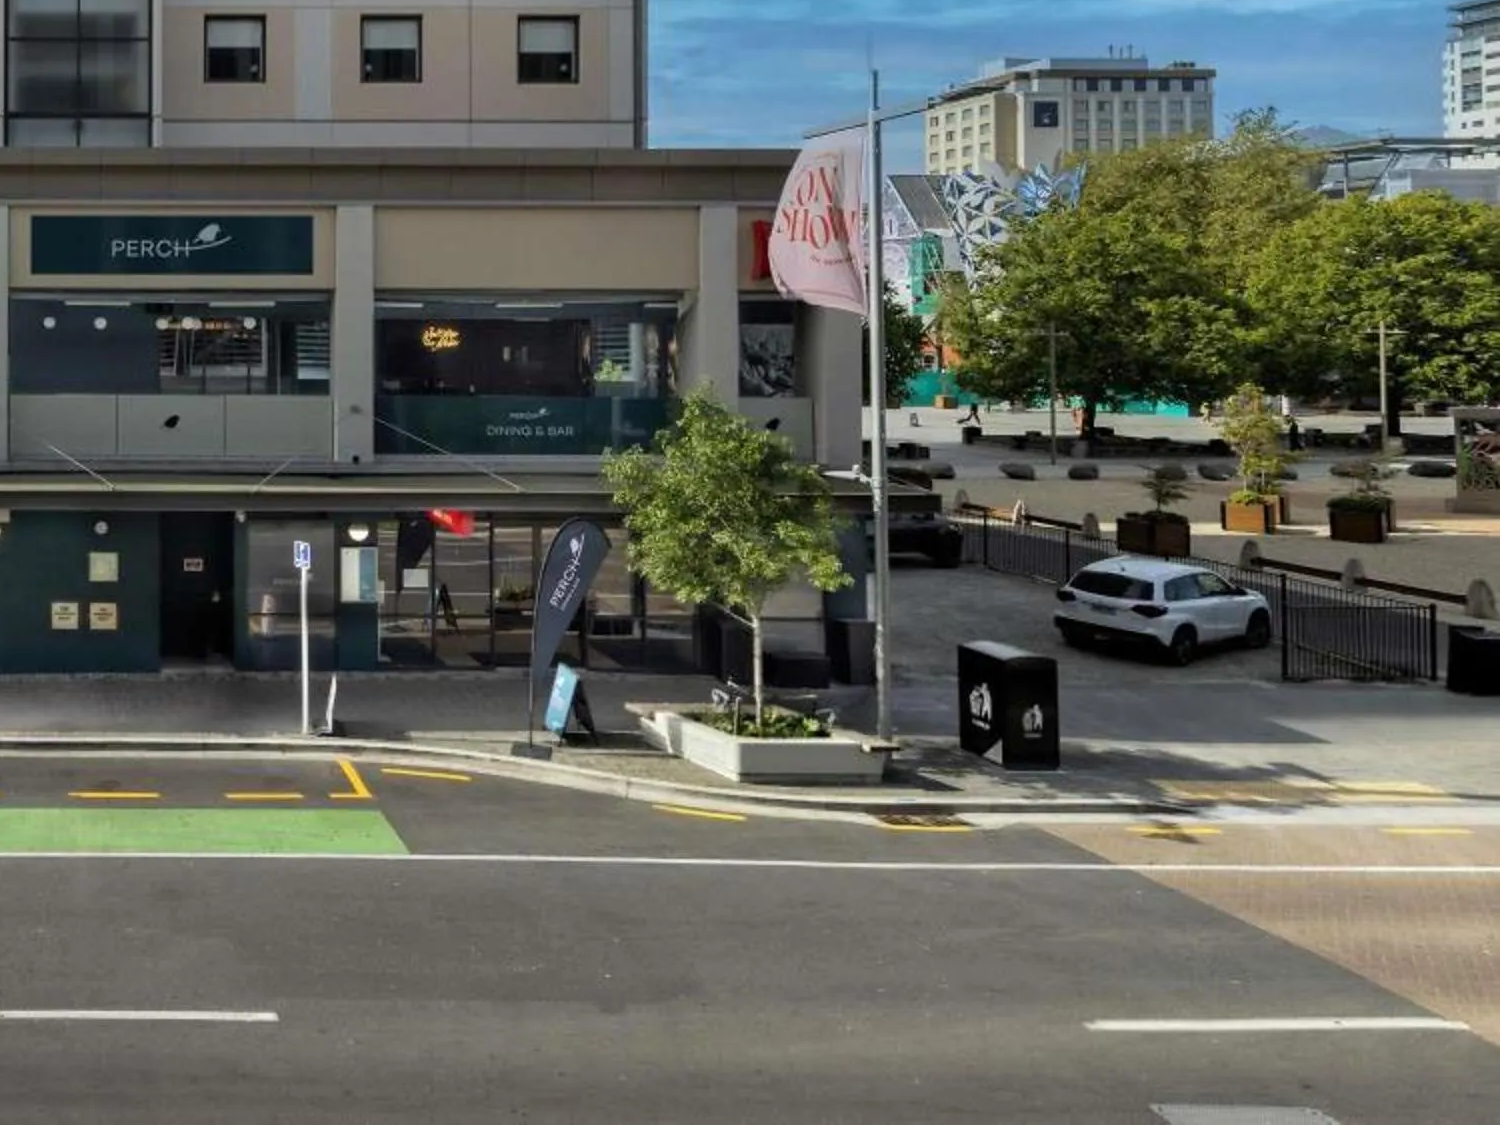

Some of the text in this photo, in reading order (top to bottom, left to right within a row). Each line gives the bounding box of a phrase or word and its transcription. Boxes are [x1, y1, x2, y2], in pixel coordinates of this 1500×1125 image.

[794, 166, 840, 206] ON
[110, 239, 190, 258] PERCH
[486, 424, 533, 436] DINING
[547, 425, 574, 436] BAR
[550, 558, 580, 608] PERCH
